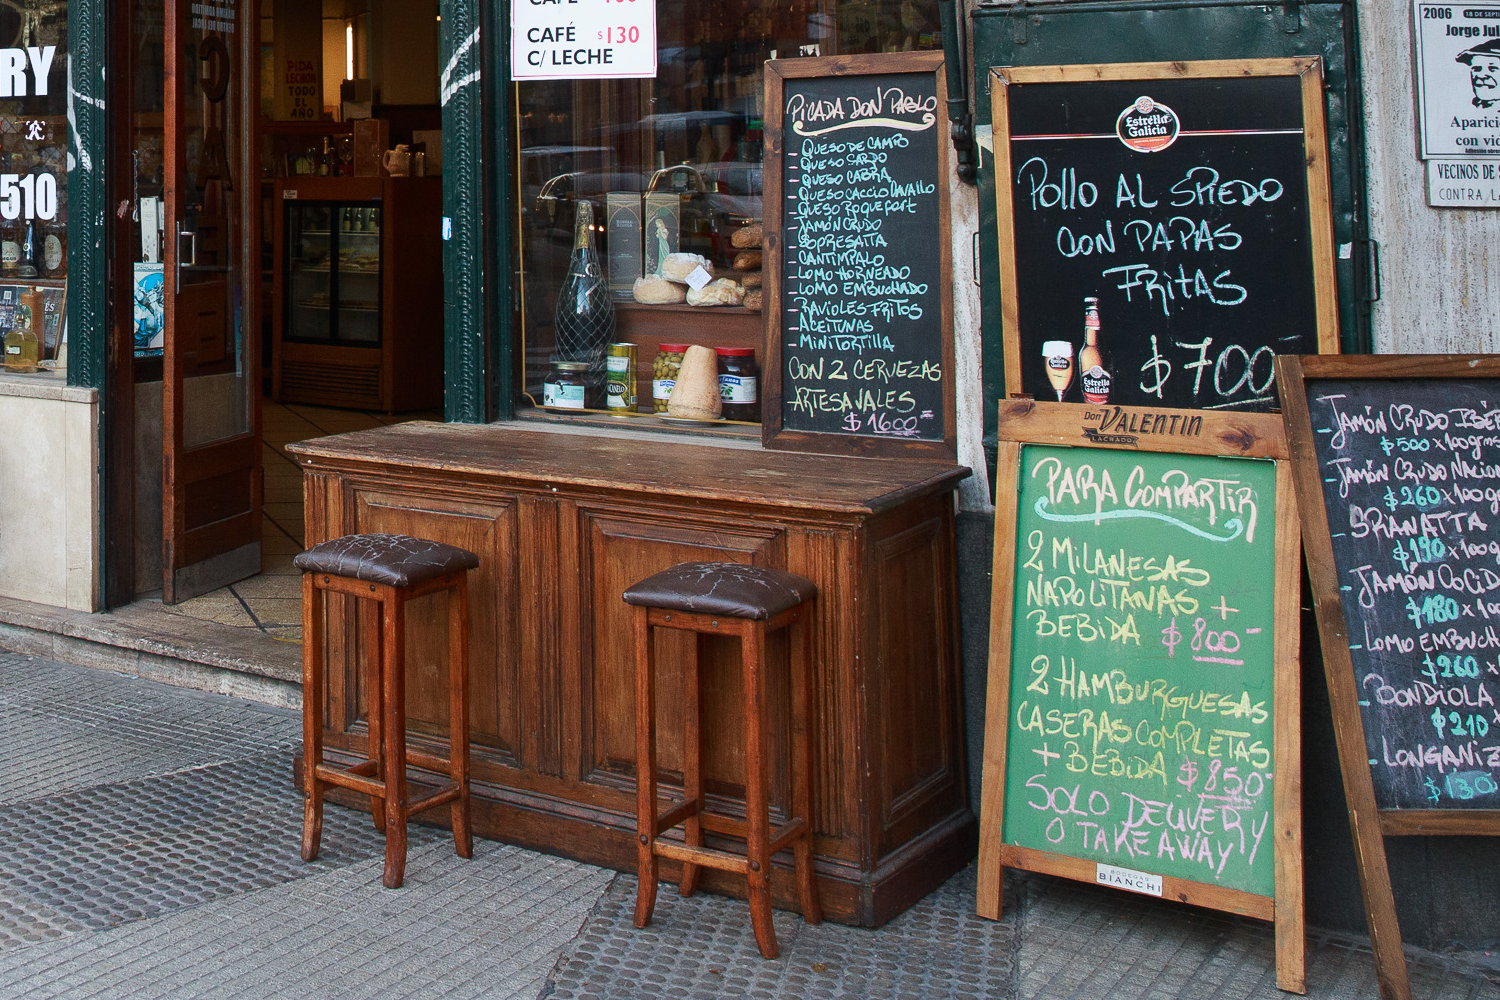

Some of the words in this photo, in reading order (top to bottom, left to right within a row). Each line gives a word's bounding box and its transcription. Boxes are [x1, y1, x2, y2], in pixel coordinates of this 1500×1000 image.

[1423, 8, 1452, 19] 2006
[527, 22, 575, 42] CAFÉ
[598, 26, 640, 43] $130
[1446, 24, 1480, 38] Jorge
[287, 61, 313, 72] PIDA
[528, 50, 546, 67] C/
[552, 49, 613, 65] LECHE
[288, 86, 315, 96] TODO
[291, 106, 313, 118] AÑO
[295, 98, 307, 107] EL
[787, 94, 845, 122] PICADA
[847, 87, 882, 118] DON
[884, 88, 937, 113] PABLO
[1126, 115, 1168, 127] Estrella
[1129, 125, 1167, 137] Galicia
[802, 139, 845, 155] QUESO
[847, 141, 864, 151] DE
[867, 133, 908, 149] CAMPO
[1456, 137, 1478, 146] con
[800, 157, 844, 172] QUESO
[846, 153, 887, 169] SARDO
[1438, 164, 1479, 179] VECINOS
[1483, 165, 1494, 179] DE
[802, 174, 843, 188] QUESO
[847, 168, 891, 184] CABRA
[799, 187, 844, 202] QUESO
[1117, 174, 1158, 208] AL
[1439, 188, 1482, 200] CONTRA
[798, 202, 840, 218] QUESO
[843, 219, 881, 232] CRUDO
[1057, 220, 1115, 257] CON
[1124, 217, 1242, 251] PAPAS
[798, 267, 833, 279] LOMO
[835, 266, 910, 282] HORNEADO
[800, 283, 837, 295] LOMO
[843, 281, 927, 296] EMBUCHADO
[1103, 264, 1247, 316] FRITAS
[794, 297, 867, 322] RAVIOLES
[867, 299, 922, 323] FRITOS
[800, 313, 873, 333] ACEITUNAS
[789, 357, 824, 379] CON
[828, 360, 848, 380] 2
[854, 359, 941, 383] CERVEZAS
[1084, 377, 1110, 386] Estrella
[1085, 385, 1109, 393] Galicia
[1084, 411, 1101, 421] Don
[1099, 406, 1203, 436] VALENTIN
[1316, 395, 1387, 449] JAMÓN
[1389, 404, 1448, 435] CRUDO
[1092, 435, 1132, 444] LACRADO
[1380, 436, 1429, 456] $500
[1326, 458, 1388, 498] JAMÓN
[1395, 457, 1447, 485] CRUDO
[1032, 458, 1117, 525] PARA
[1125, 466, 1257, 543] COMPARTIR
[1384, 485, 1441, 512] $260
[1023, 530, 1043, 571] 2
[1053, 537, 1210, 587] MILANESAS
[1027, 574, 1198, 616] NAPOLITANAS
[1349, 562, 1434, 610] JAMÓN
[1027, 610, 1140, 646] BEBIDA
[1364, 621, 1414, 653] LOMO
[1421, 653, 1480, 684] $260
[1027, 655, 1049, 694] 2
[1054, 656, 1269, 724] HAMBURGUESAS
[1431, 707, 1488, 739] $210
[1017, 701, 1133, 752] CASERAS
[1136, 720, 1270, 768] COMPLETAS
[1065, 741, 1168, 786] BEBIDA
[1025, 774, 1109, 816] SOLO
[1122, 792, 1269, 865] DELIVERY
[1076, 821, 1149, 858] TAKE
[1157, 829, 1233, 880] AWAY
[1099, 873, 1161, 892] BIANCHI
[1110, 870, 1149, 881] BODEGAS
